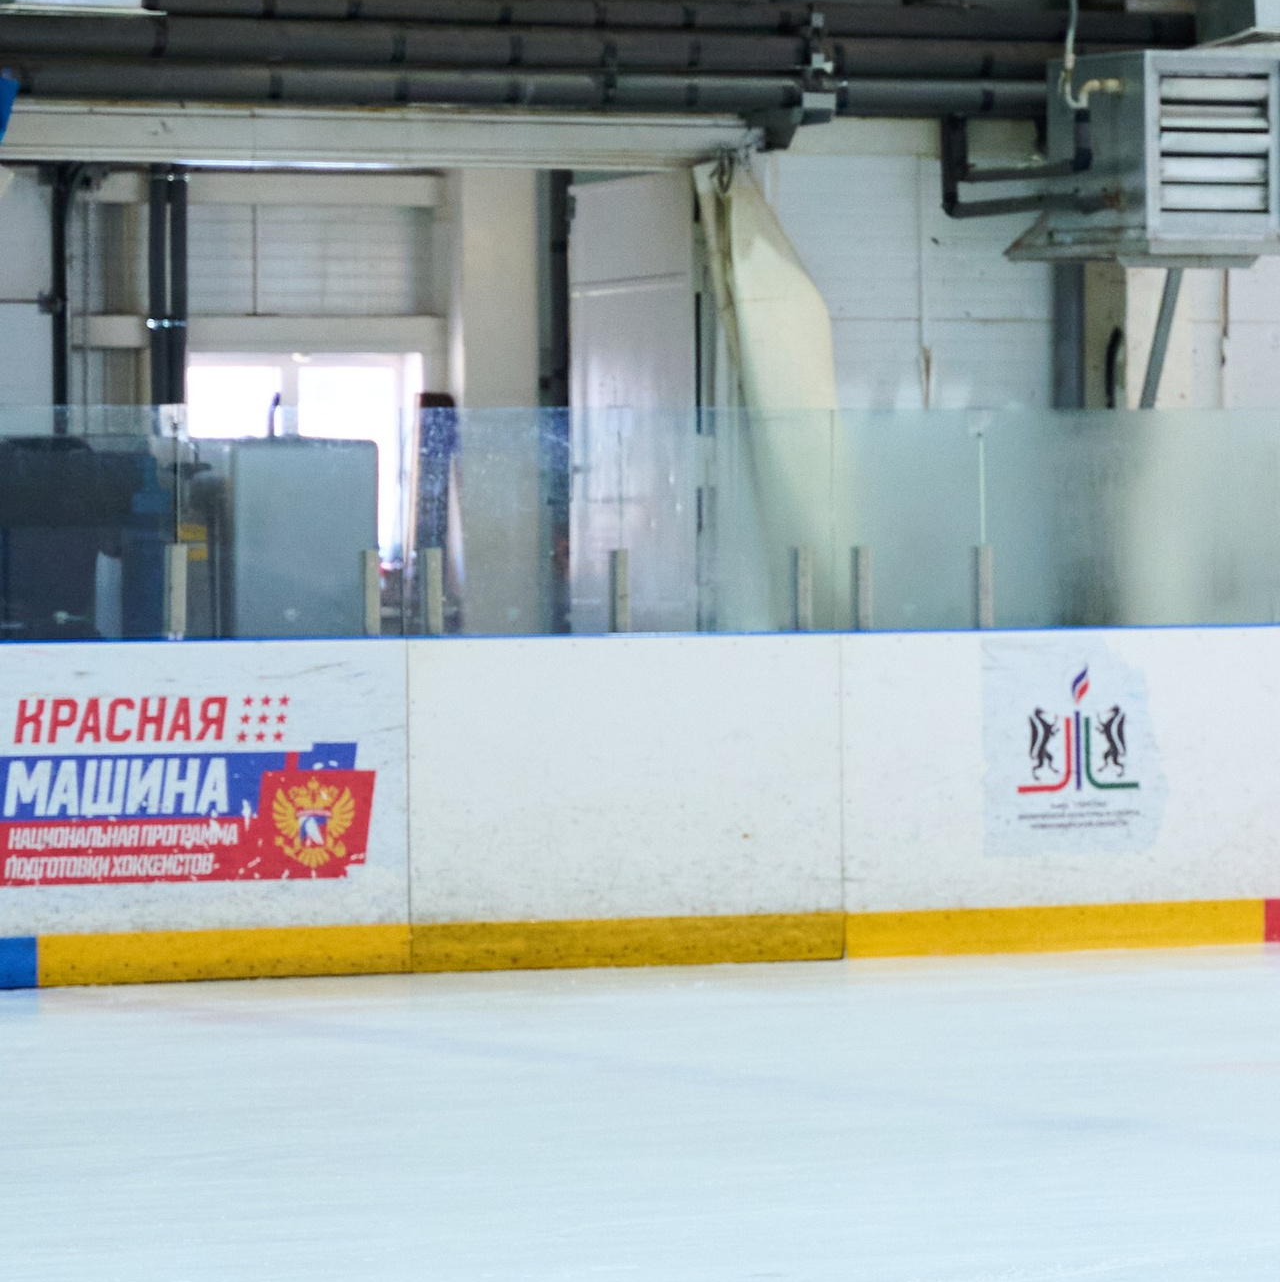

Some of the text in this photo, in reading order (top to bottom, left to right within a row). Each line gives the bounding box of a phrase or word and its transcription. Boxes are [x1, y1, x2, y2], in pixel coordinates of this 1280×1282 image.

[13, 696, 228, 744] КРАСНАЯ
[4, 757, 229, 817] МАШИНА
[8, 823, 239, 850] НАЦИОНАЛЬНАЯ ПРОГРАММА
[4, 855, 109, 879] ПОДГОТОВКИ
